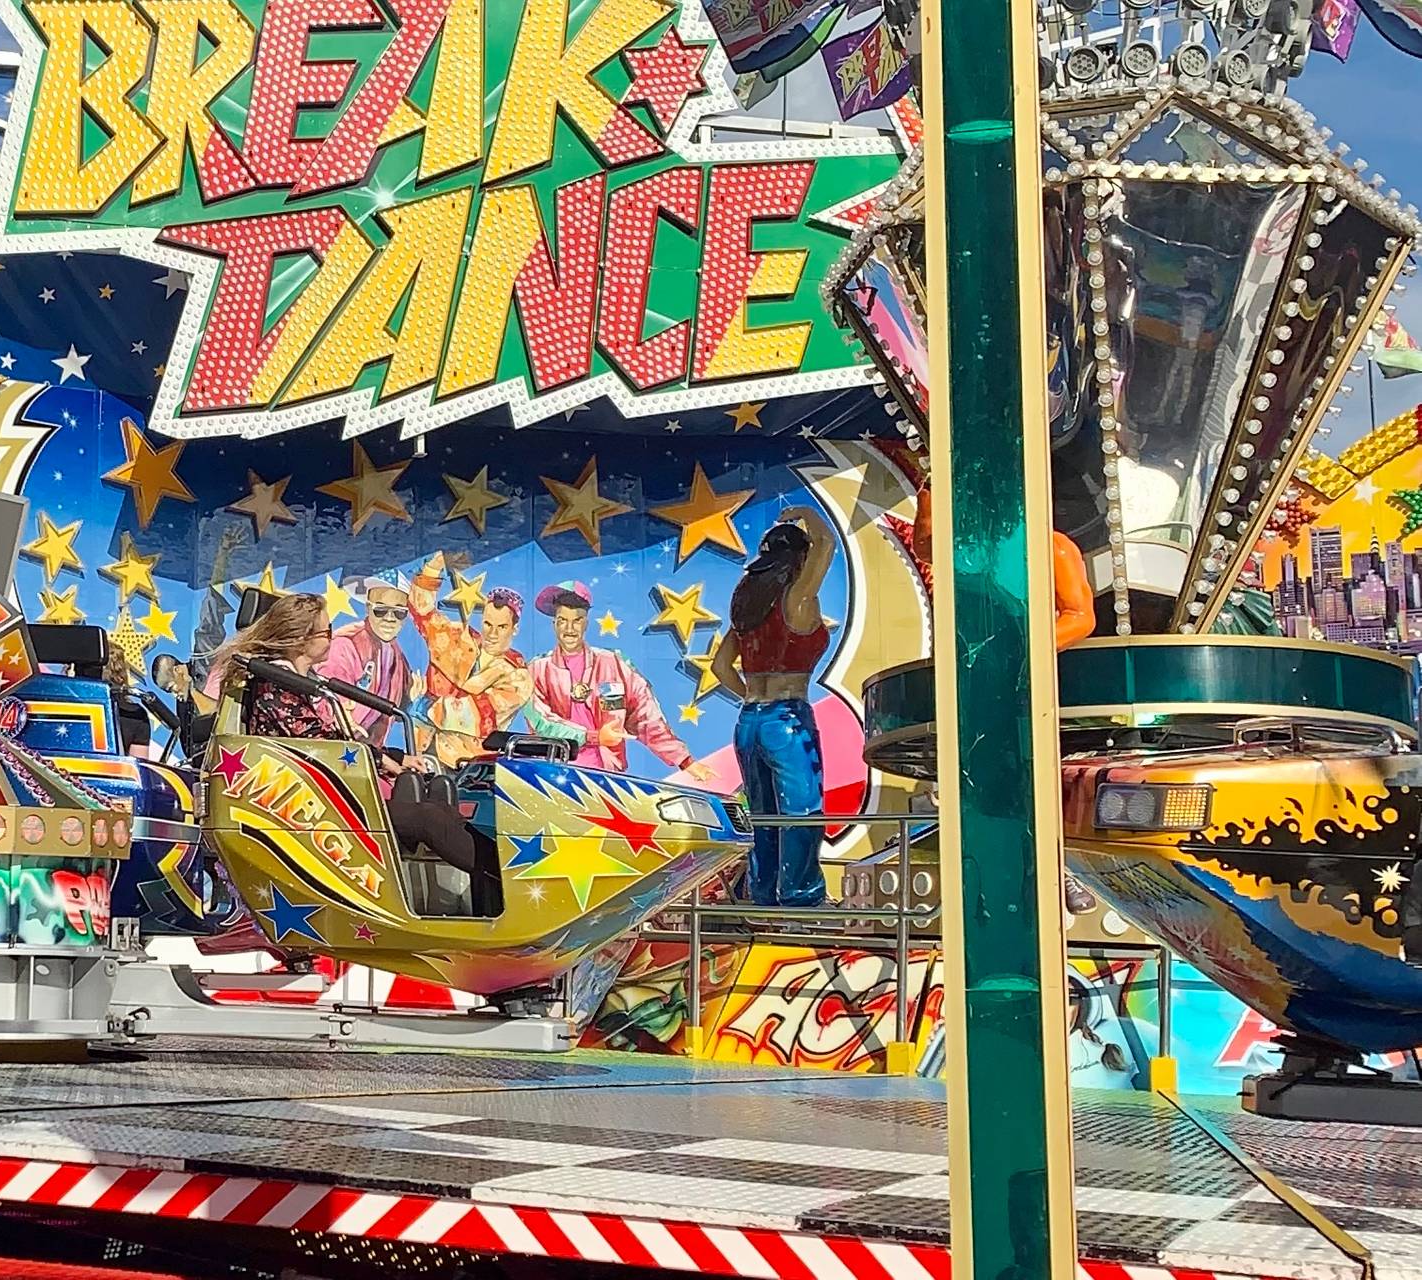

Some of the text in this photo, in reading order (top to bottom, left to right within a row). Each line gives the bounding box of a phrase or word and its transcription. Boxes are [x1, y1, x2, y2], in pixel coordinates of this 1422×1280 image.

[12, 0, 678, 216] BREAK
[155, 159, 817, 414] DANCE
[221, 753, 385, 899] MEGA
